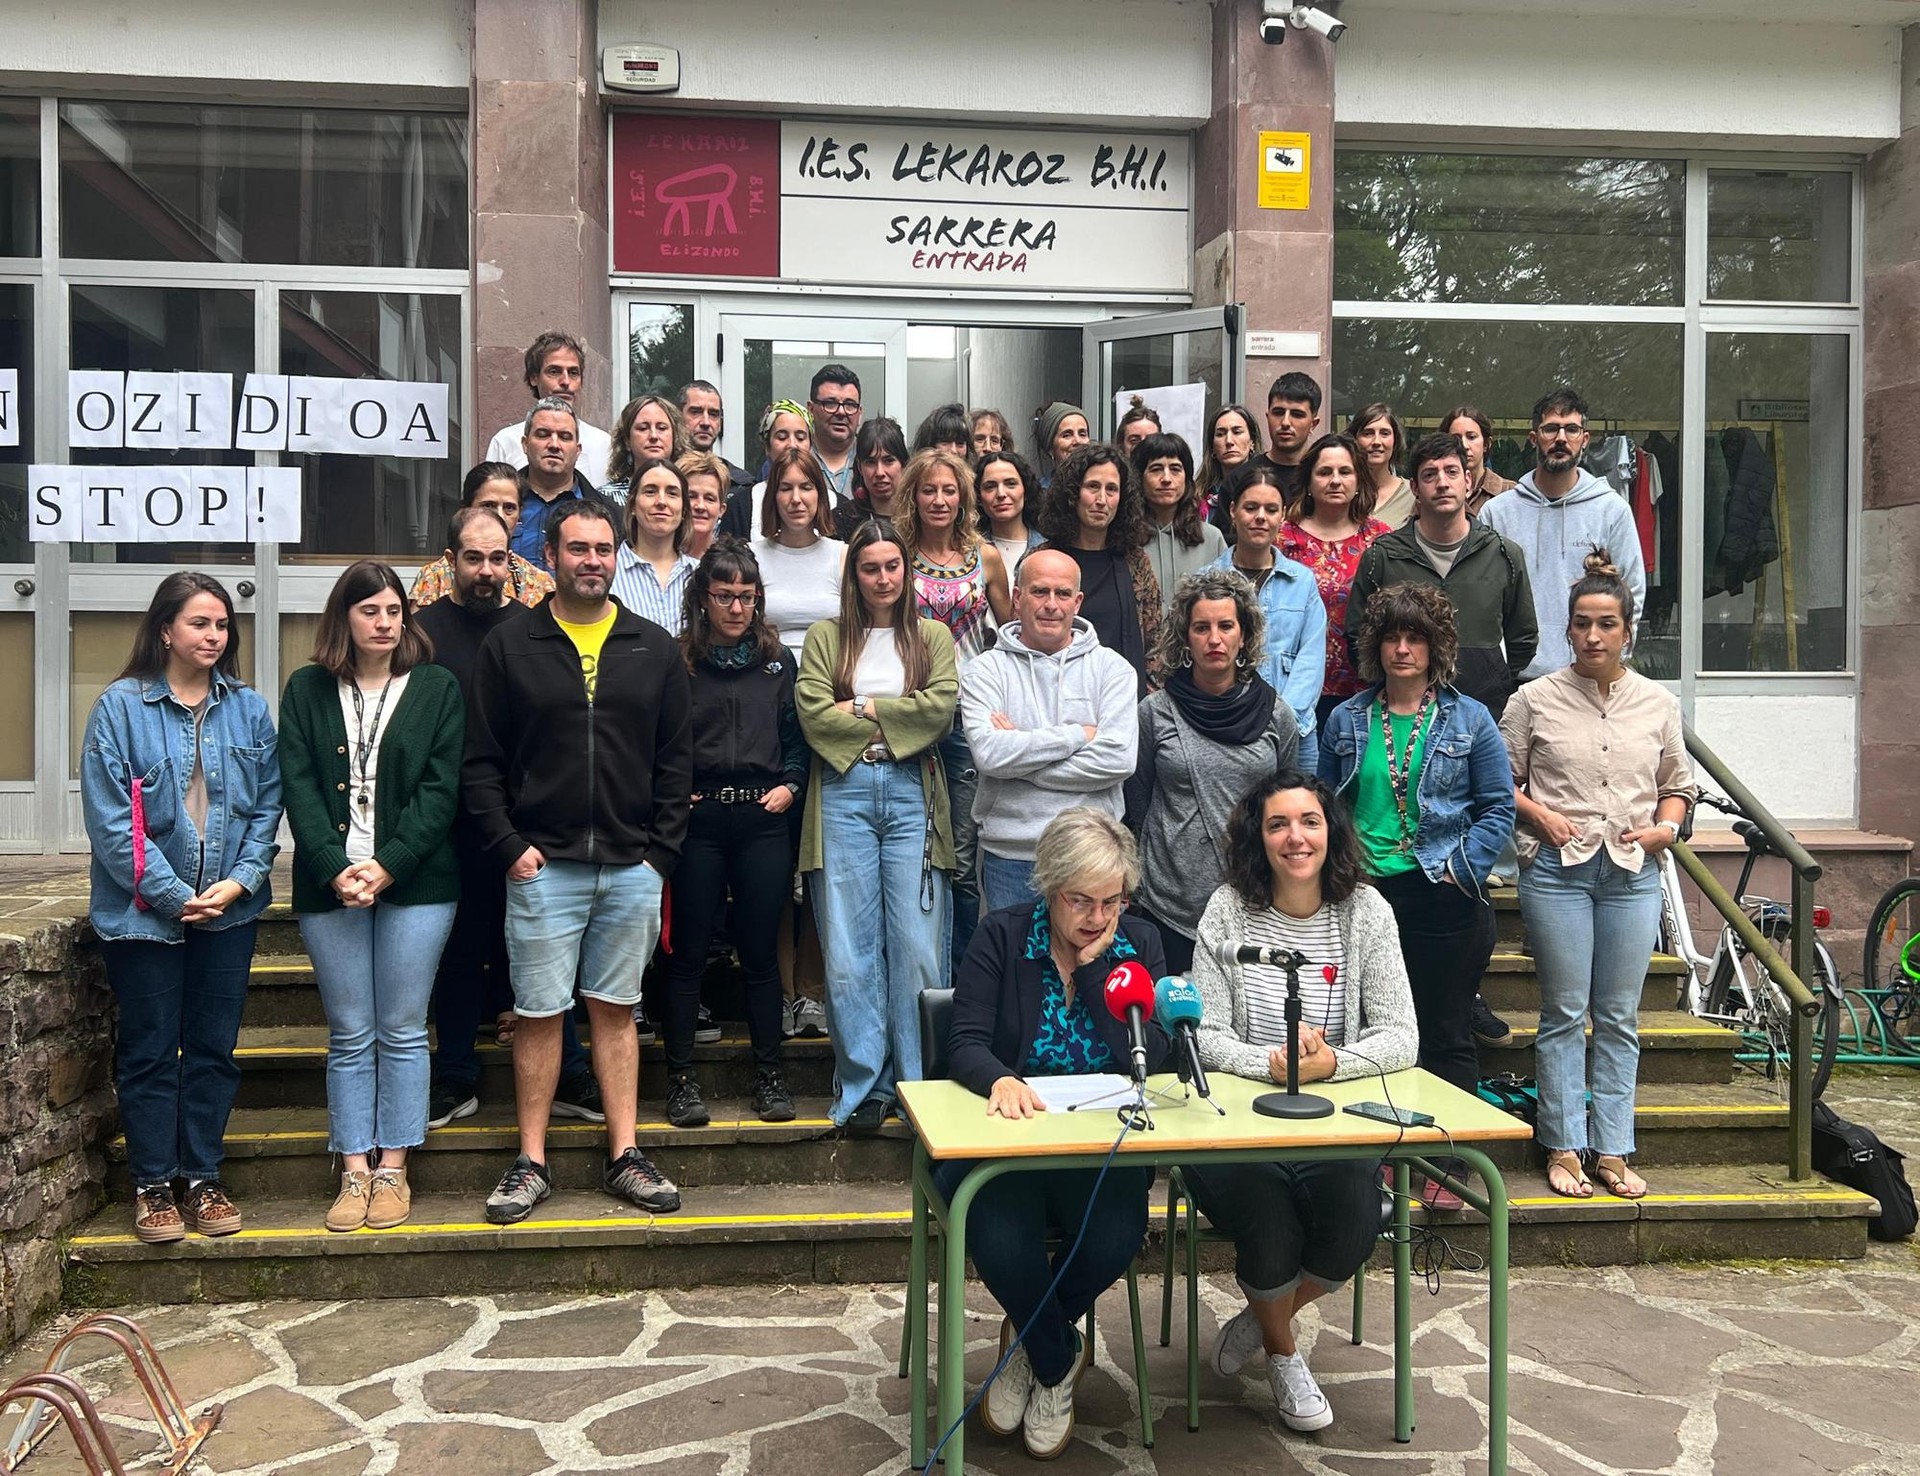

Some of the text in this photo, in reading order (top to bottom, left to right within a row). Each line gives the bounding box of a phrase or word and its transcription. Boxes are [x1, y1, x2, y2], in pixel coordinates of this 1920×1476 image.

[799, 136, 1167, 191] I.E.S. LEKAROZ B.H.I.
[886, 215, 1057, 250] SARRERA
[912, 250, 1028, 272] ENTRADA
[35, 485, 266, 528] STOP!
